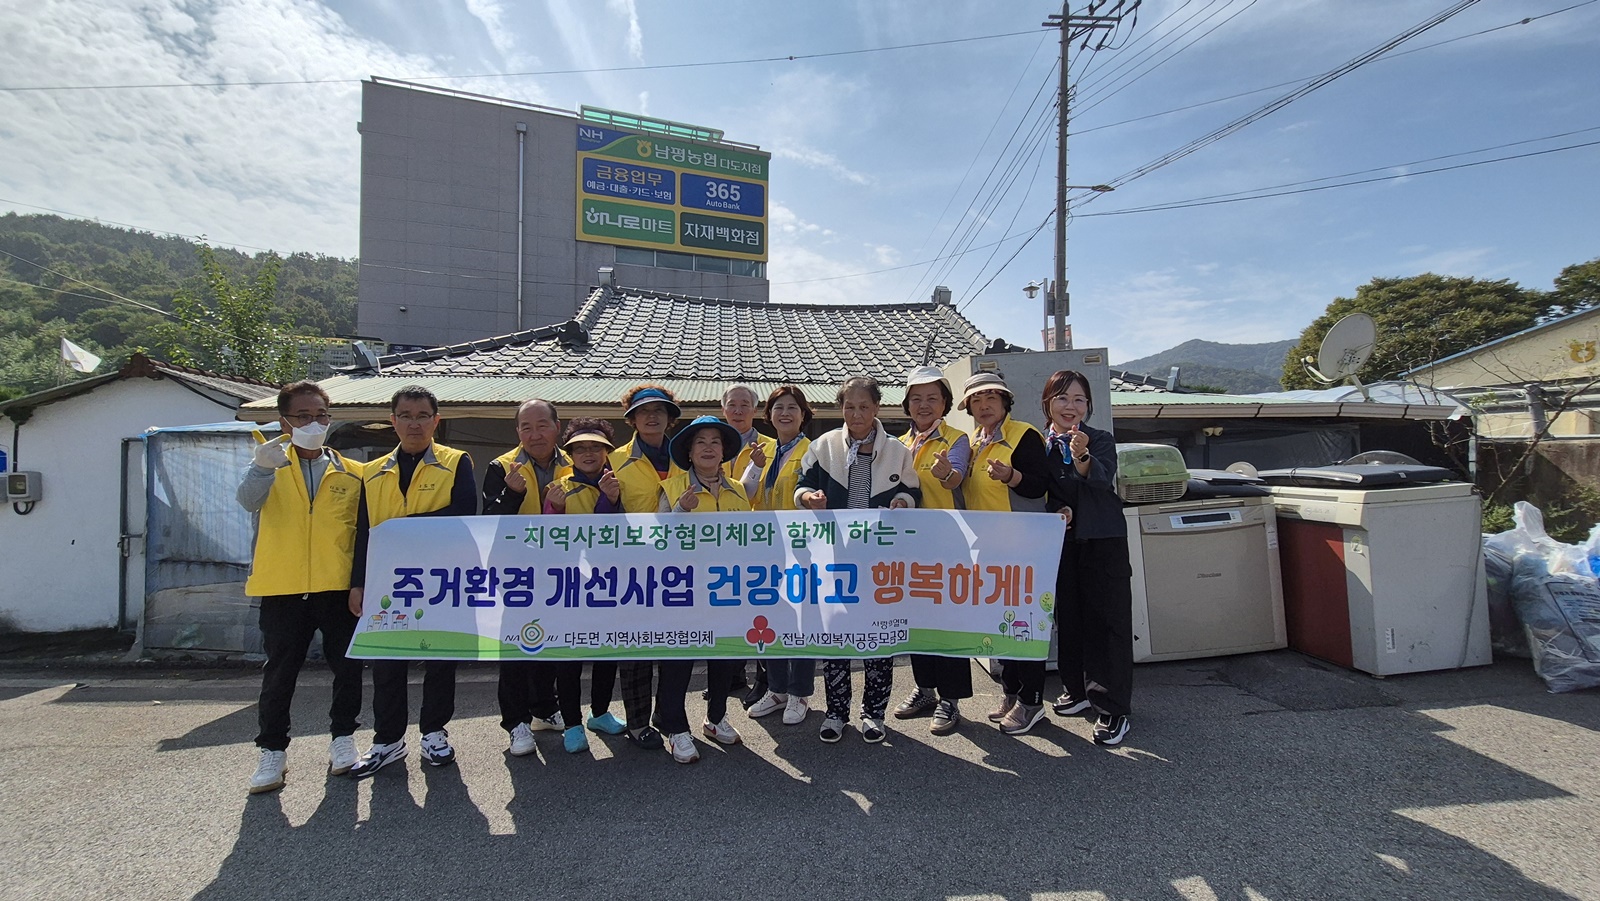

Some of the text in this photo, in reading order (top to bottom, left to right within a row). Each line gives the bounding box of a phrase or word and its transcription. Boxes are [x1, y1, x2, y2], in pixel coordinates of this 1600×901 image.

[579, 127, 603, 140] NH
[654, 144, 761, 174] 남평농협 다도지점
[596, 165, 662, 186] 금융업무
[706, 181, 741, 201] 365
[706, 200, 740, 210] Auto Bank
[684, 222, 760, 246] 자재백화점
[786, 521, 836, 549] 함께
[392, 561, 1034, 608] 주거환경 개선사업 건강하고 행복하게!
[564, 630, 714, 646] 다도면 지역사회보장협의체
[782, 632, 806, 646] 전남
